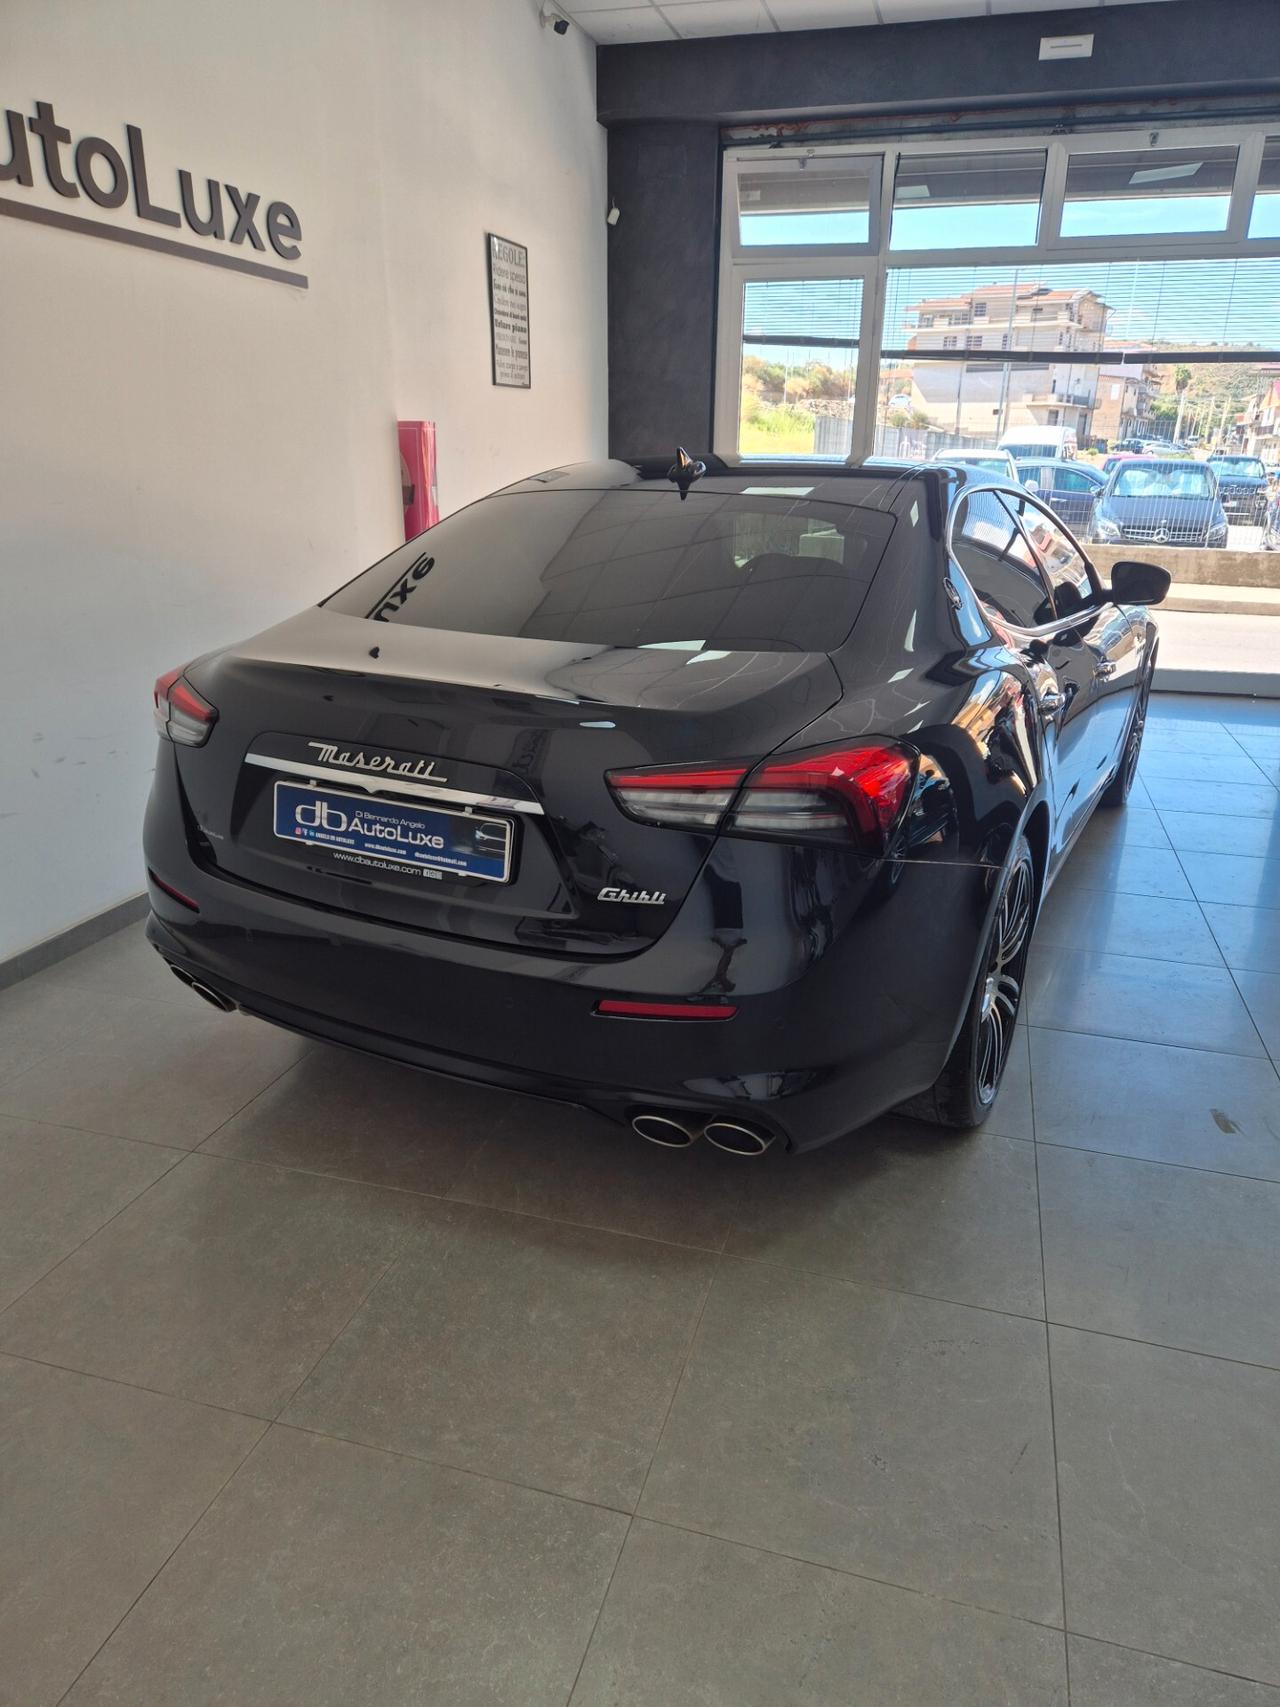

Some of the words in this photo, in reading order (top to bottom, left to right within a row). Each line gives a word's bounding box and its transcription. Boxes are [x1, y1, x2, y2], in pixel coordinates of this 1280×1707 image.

[308, 742, 447, 783] Maserati
[295, 800, 348, 832] db
[399, 818, 426, 830] Angelo
[348, 817, 445, 849] AutoLuxe
[333, 852, 421, 876] www.dbautoluxe.com
[597, 887, 666, 905] Ghibli
